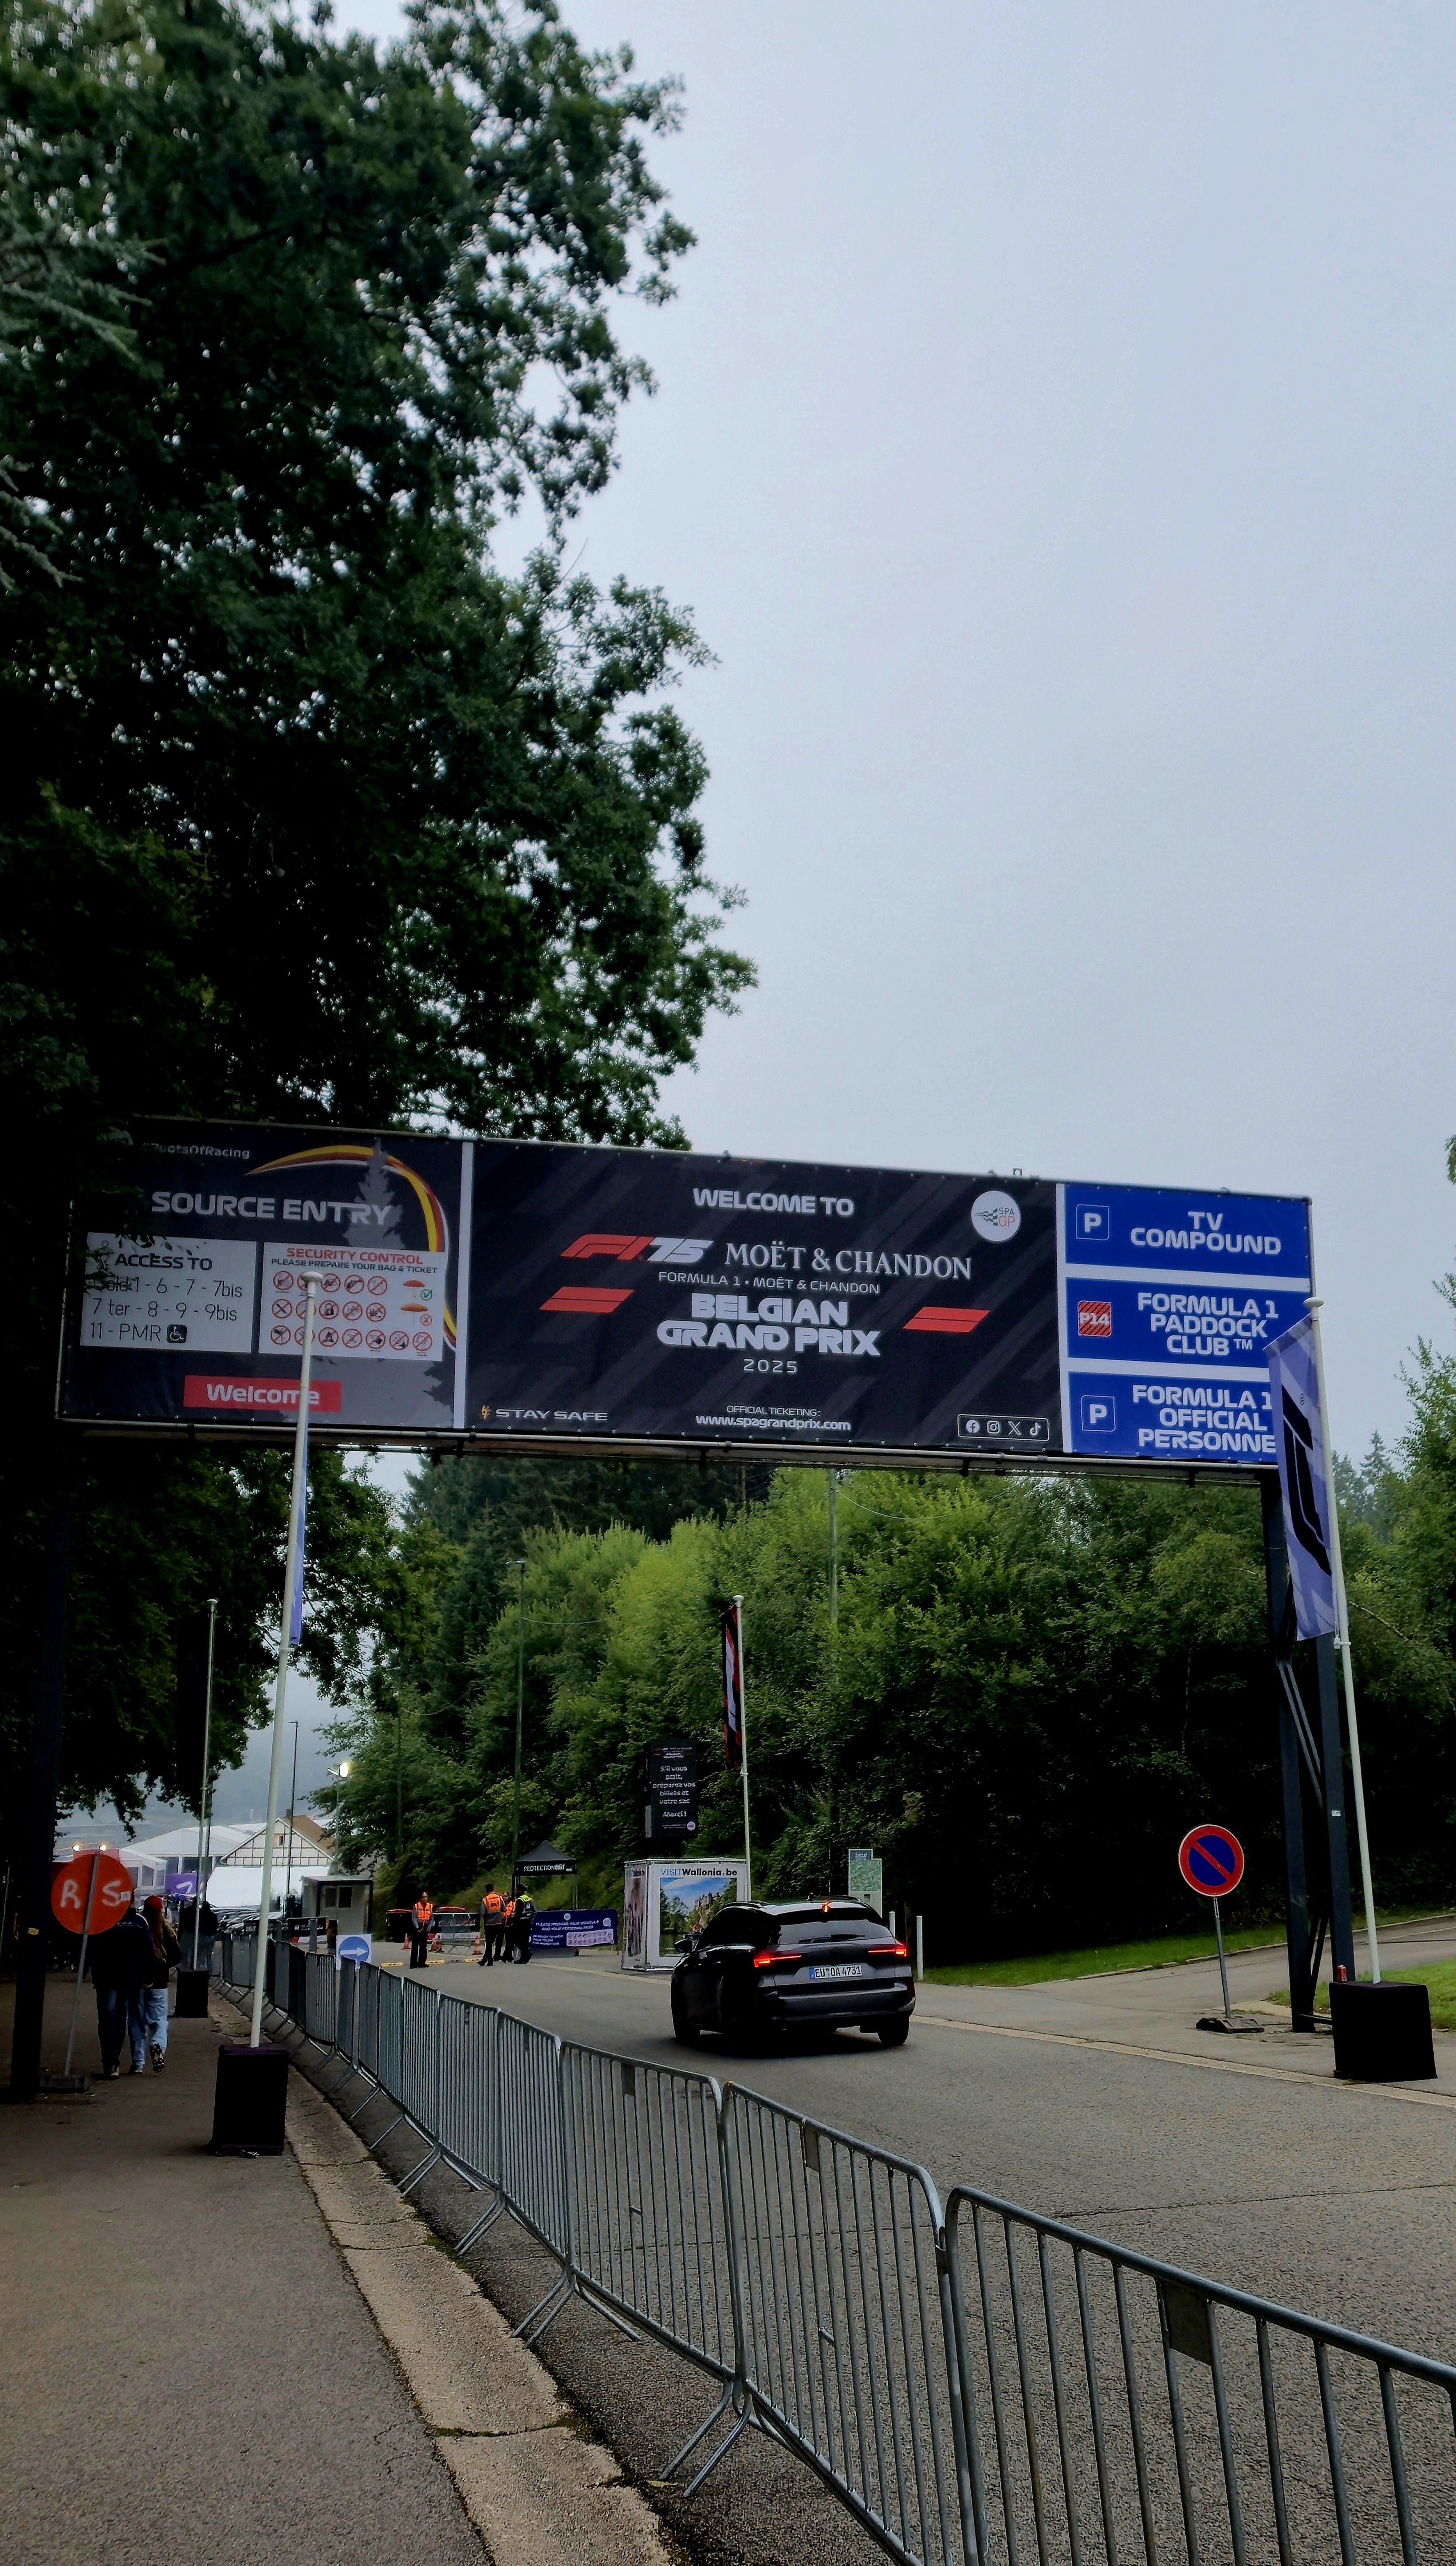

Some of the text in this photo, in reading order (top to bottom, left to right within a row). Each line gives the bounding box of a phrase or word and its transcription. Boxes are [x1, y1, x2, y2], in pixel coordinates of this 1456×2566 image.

[152, 1191, 392, 1225] SOURCE ENTRY
[693, 1188, 854, 1216] WELCOME TO
[999, 1215, 1015, 1227] GP
[1084, 1213, 1101, 1232] P
[1188, 1211, 1223, 1231] TV
[1130, 1228, 1281, 1255] COMPOUND
[115, 1254, 213, 1271] ACCESS TO
[287, 1248, 424, 1265] SECURITY CONTROL
[308, 1260, 350, 1269] PREPARE
[726, 1240, 972, 1281] MOËT & CHANDON
[156, 1277, 168, 1294] 6
[186, 1279, 195, 1295] 7
[213, 1280, 243, 1297] 7bis
[658, 1271, 729, 1286] FORMULA
[733, 1275, 741, 1286] 1
[753, 1277, 795, 1289] MOËT
[798, 1280, 807, 1290] &
[810, 1281, 880, 1294] CHANDON
[93, 1298, 102, 1314] 7
[109, 1299, 130, 1316] ter
[148, 1301, 158, 1317] 8
[176, 1302, 187, 1318] 9
[205, 1303, 237, 1321] 9bis
[691, 1292, 848, 1326] BELGIAN
[1137, 1292, 1279, 1318] FORMULA 1
[1079, 1312, 1110, 1325] P14
[1150, 1314, 1267, 1338] PADDOCK
[119, 1323, 161, 1342] PMR
[657, 1320, 881, 1357] GRAND PRIX
[743, 1358, 797, 1374] 2025
[206, 1384, 319, 1405] Welcome
[1133, 1384, 1273, 1409] FORMULA 1
[496, 1408, 608, 1421] STAY SAFE
[726, 1405, 821, 1417] OFFICIAL TICKETING:
[1089, 1404, 1107, 1424] P
[1159, 1407, 1267, 1431] OFFICIAL
[696, 1415, 852, 1431] www.spagrandprix.com
[1138, 1429, 1276, 1453] PERSONNE
[60, 1879, 121, 1909] R S
[815, 1968, 825, 1977] EU
[842, 1966, 861, 1976] 4731
